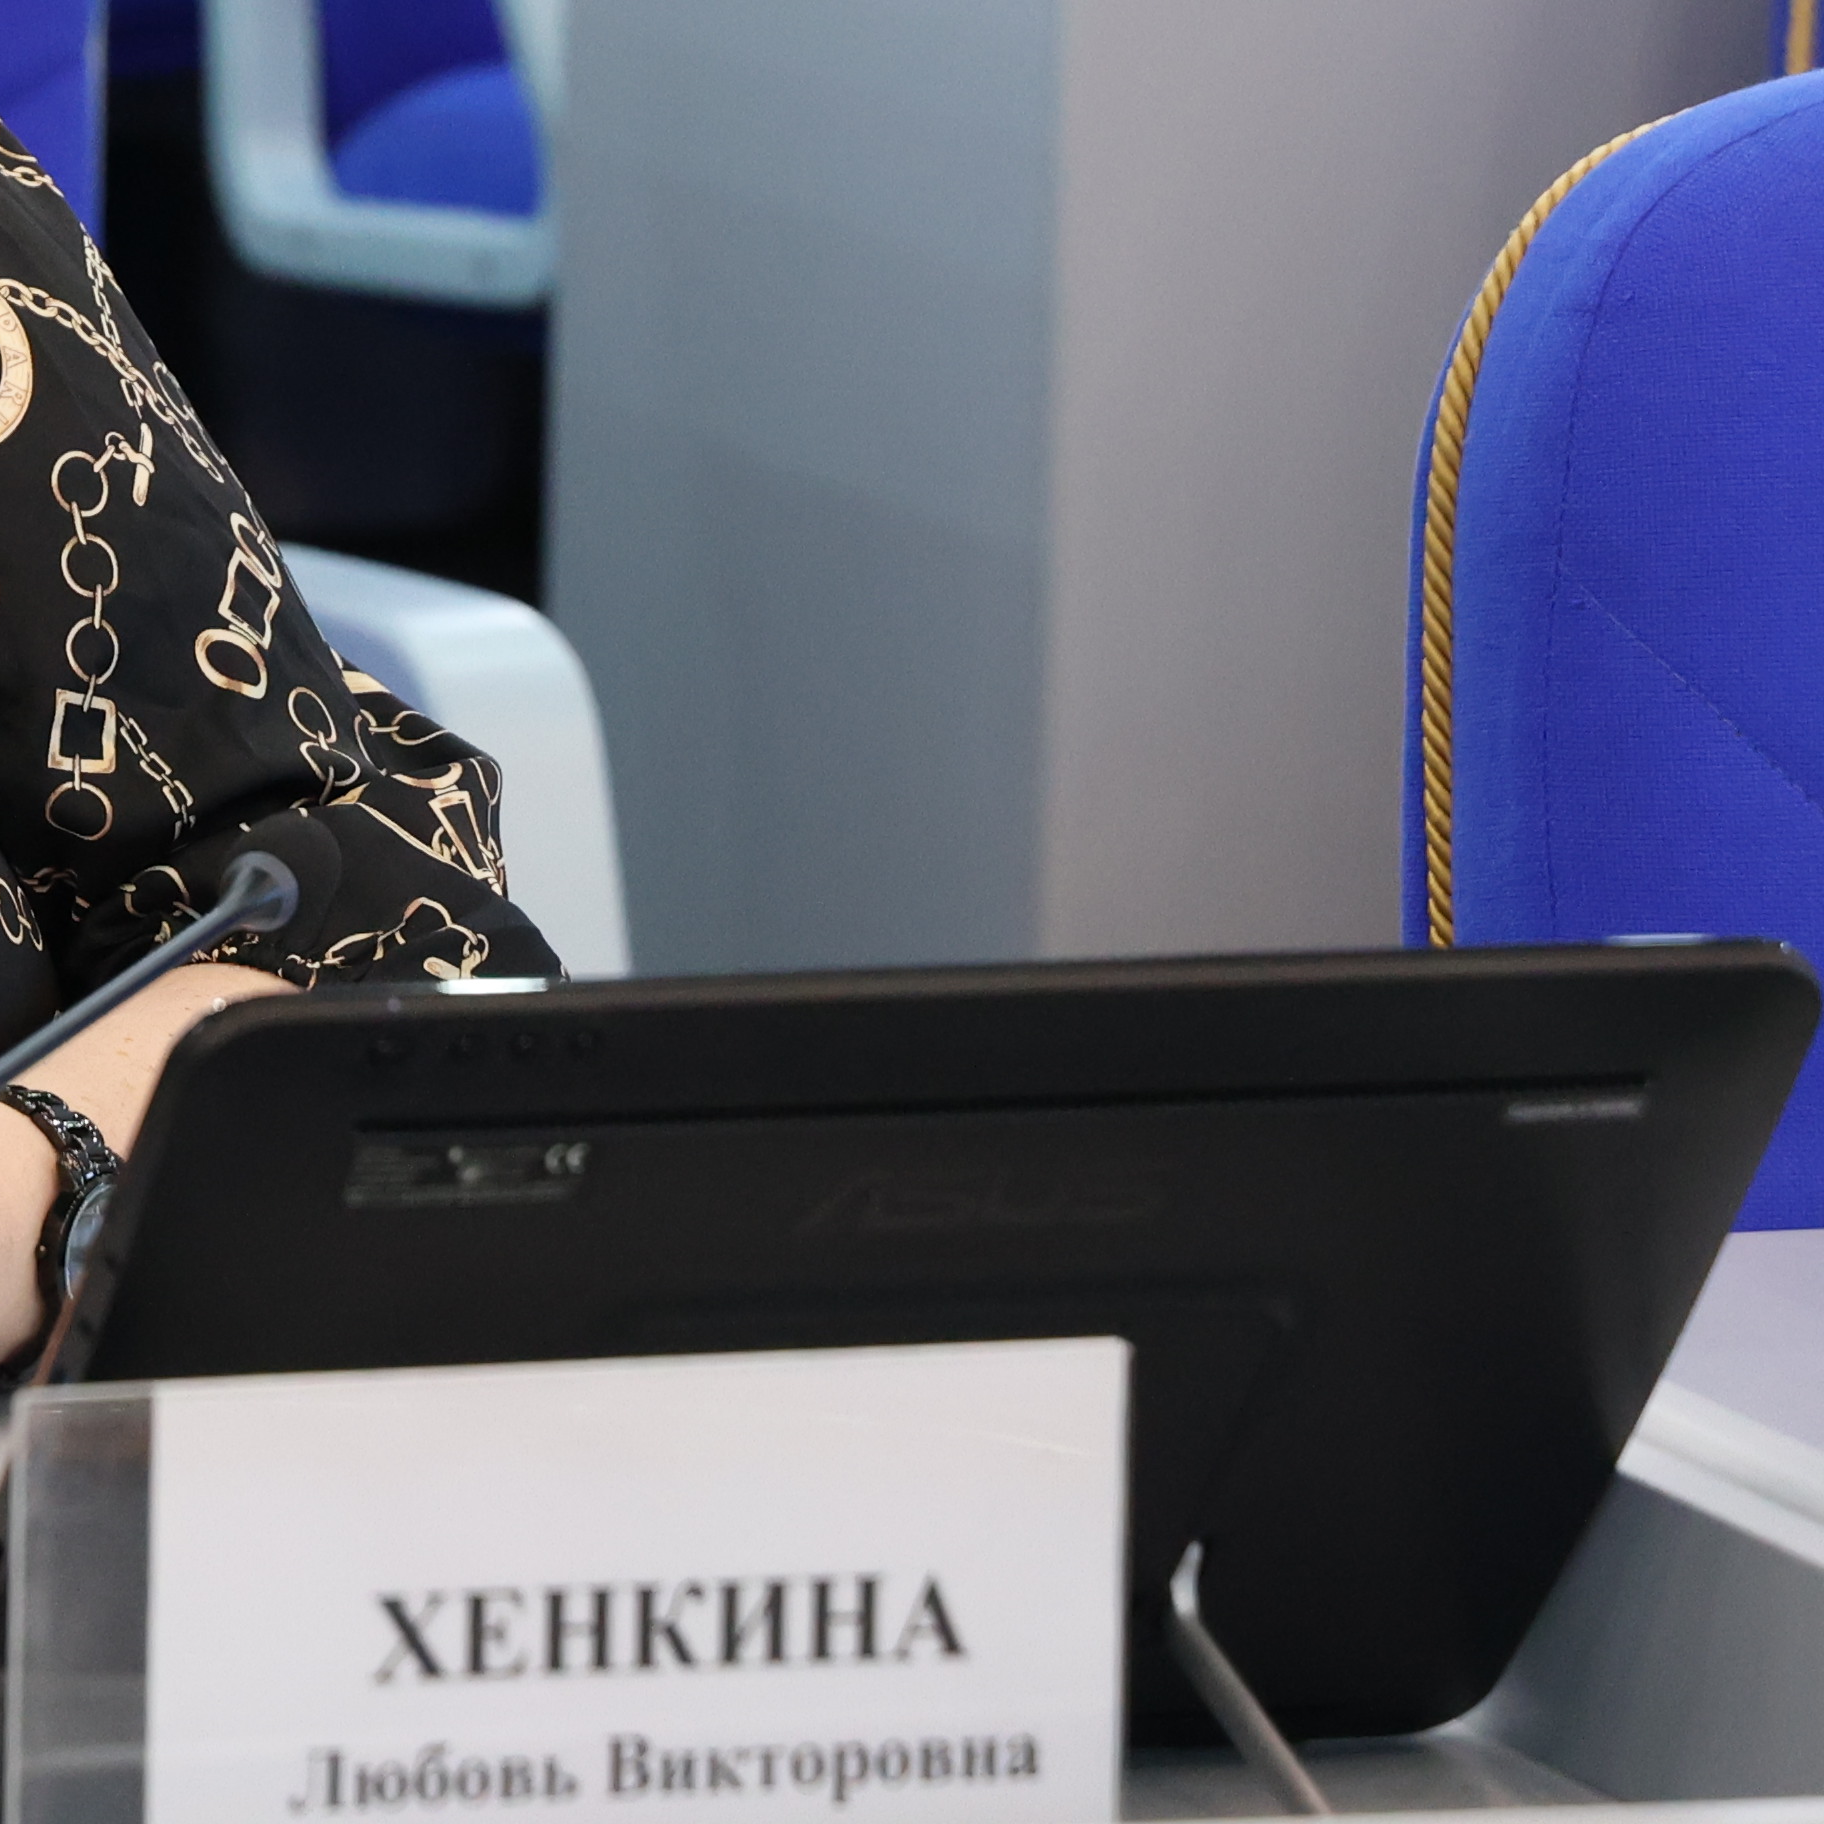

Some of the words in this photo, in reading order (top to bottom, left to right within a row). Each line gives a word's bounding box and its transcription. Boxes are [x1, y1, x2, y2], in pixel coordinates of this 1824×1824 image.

[372, 1572, 965, 1684] ХЕНКИНА
[287, 1740, 578, 1815] Любовь
[605, 1730, 1040, 1808] Викторовна
